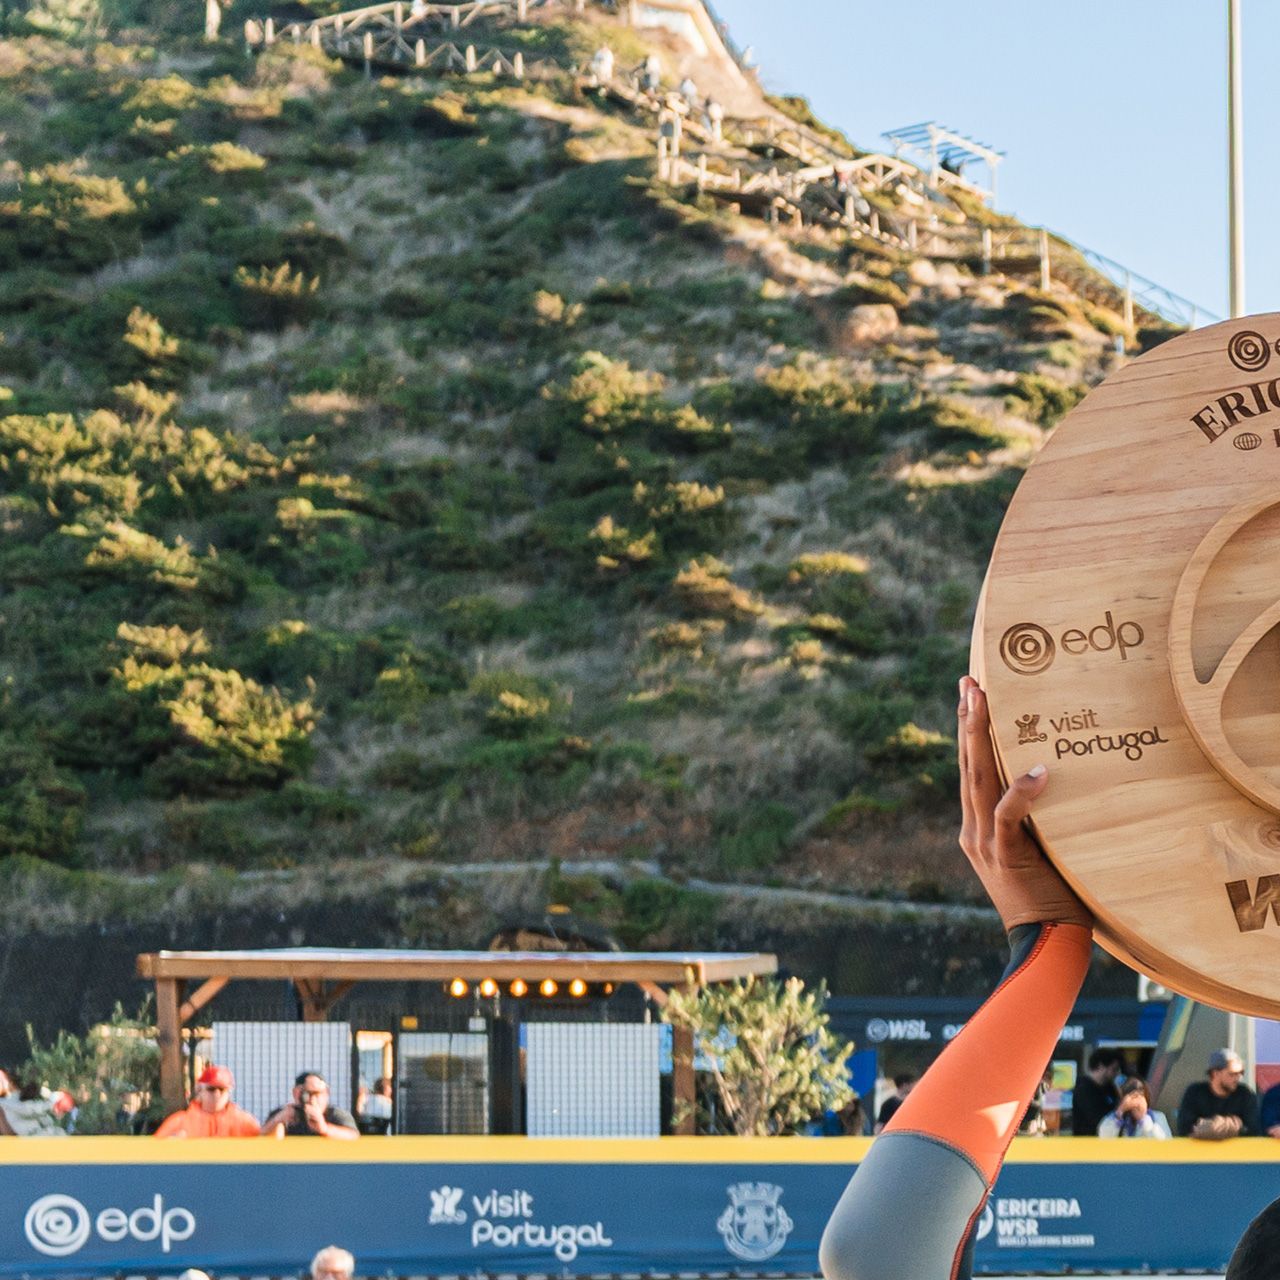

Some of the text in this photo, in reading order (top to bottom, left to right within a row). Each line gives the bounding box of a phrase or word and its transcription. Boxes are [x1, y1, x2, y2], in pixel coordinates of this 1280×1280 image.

[1061, 610, 1145, 660] edp
[1049, 708, 1100, 734] visit
[1055, 727, 1169, 762] Portugal
[888, 1020, 930, 1041] WSL
[472, 1188, 533, 1219] visit
[997, 1198, 1082, 1218] ERICEIRA
[97, 1193, 197, 1254] edp
[997, 1218, 1039, 1236] WSR
[471, 1219, 613, 1263] Portugal
